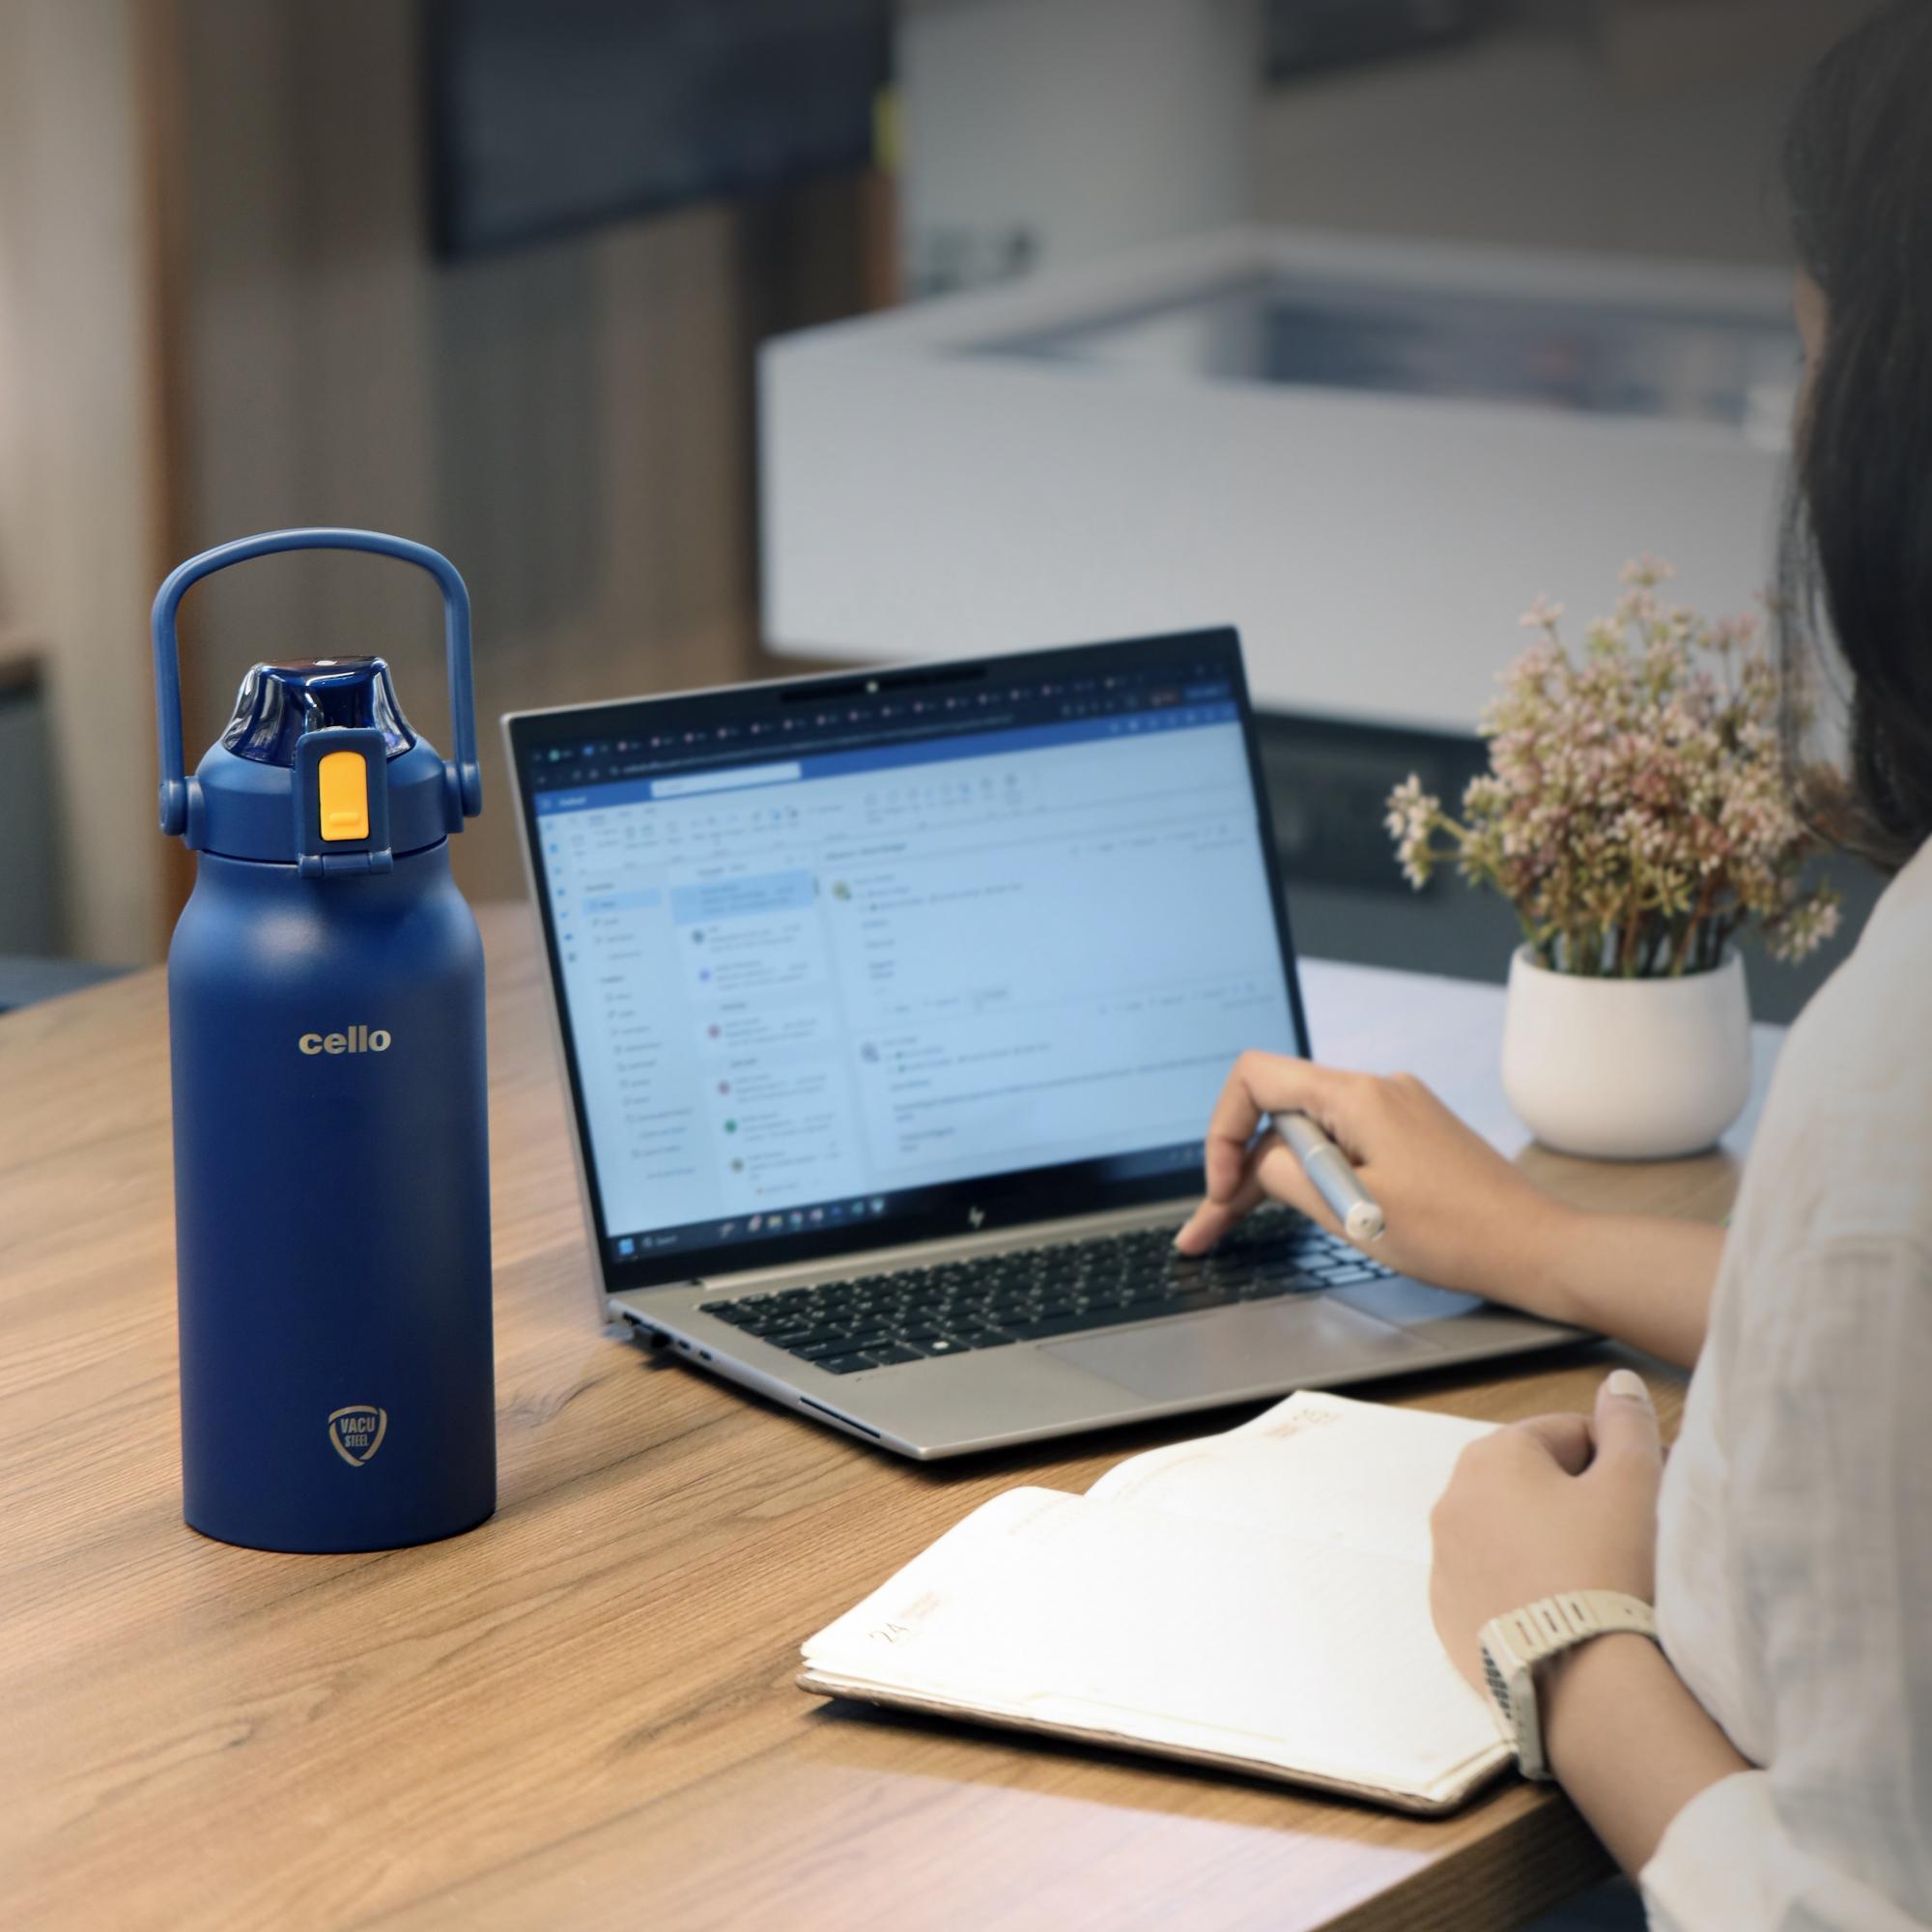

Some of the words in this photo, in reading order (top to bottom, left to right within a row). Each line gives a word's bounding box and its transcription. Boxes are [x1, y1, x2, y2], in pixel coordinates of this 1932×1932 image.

[298, 1025, 391, 1055] cello
[340, 1416, 376, 1434] VACU
[345, 1434, 369, 1448] STEEL
